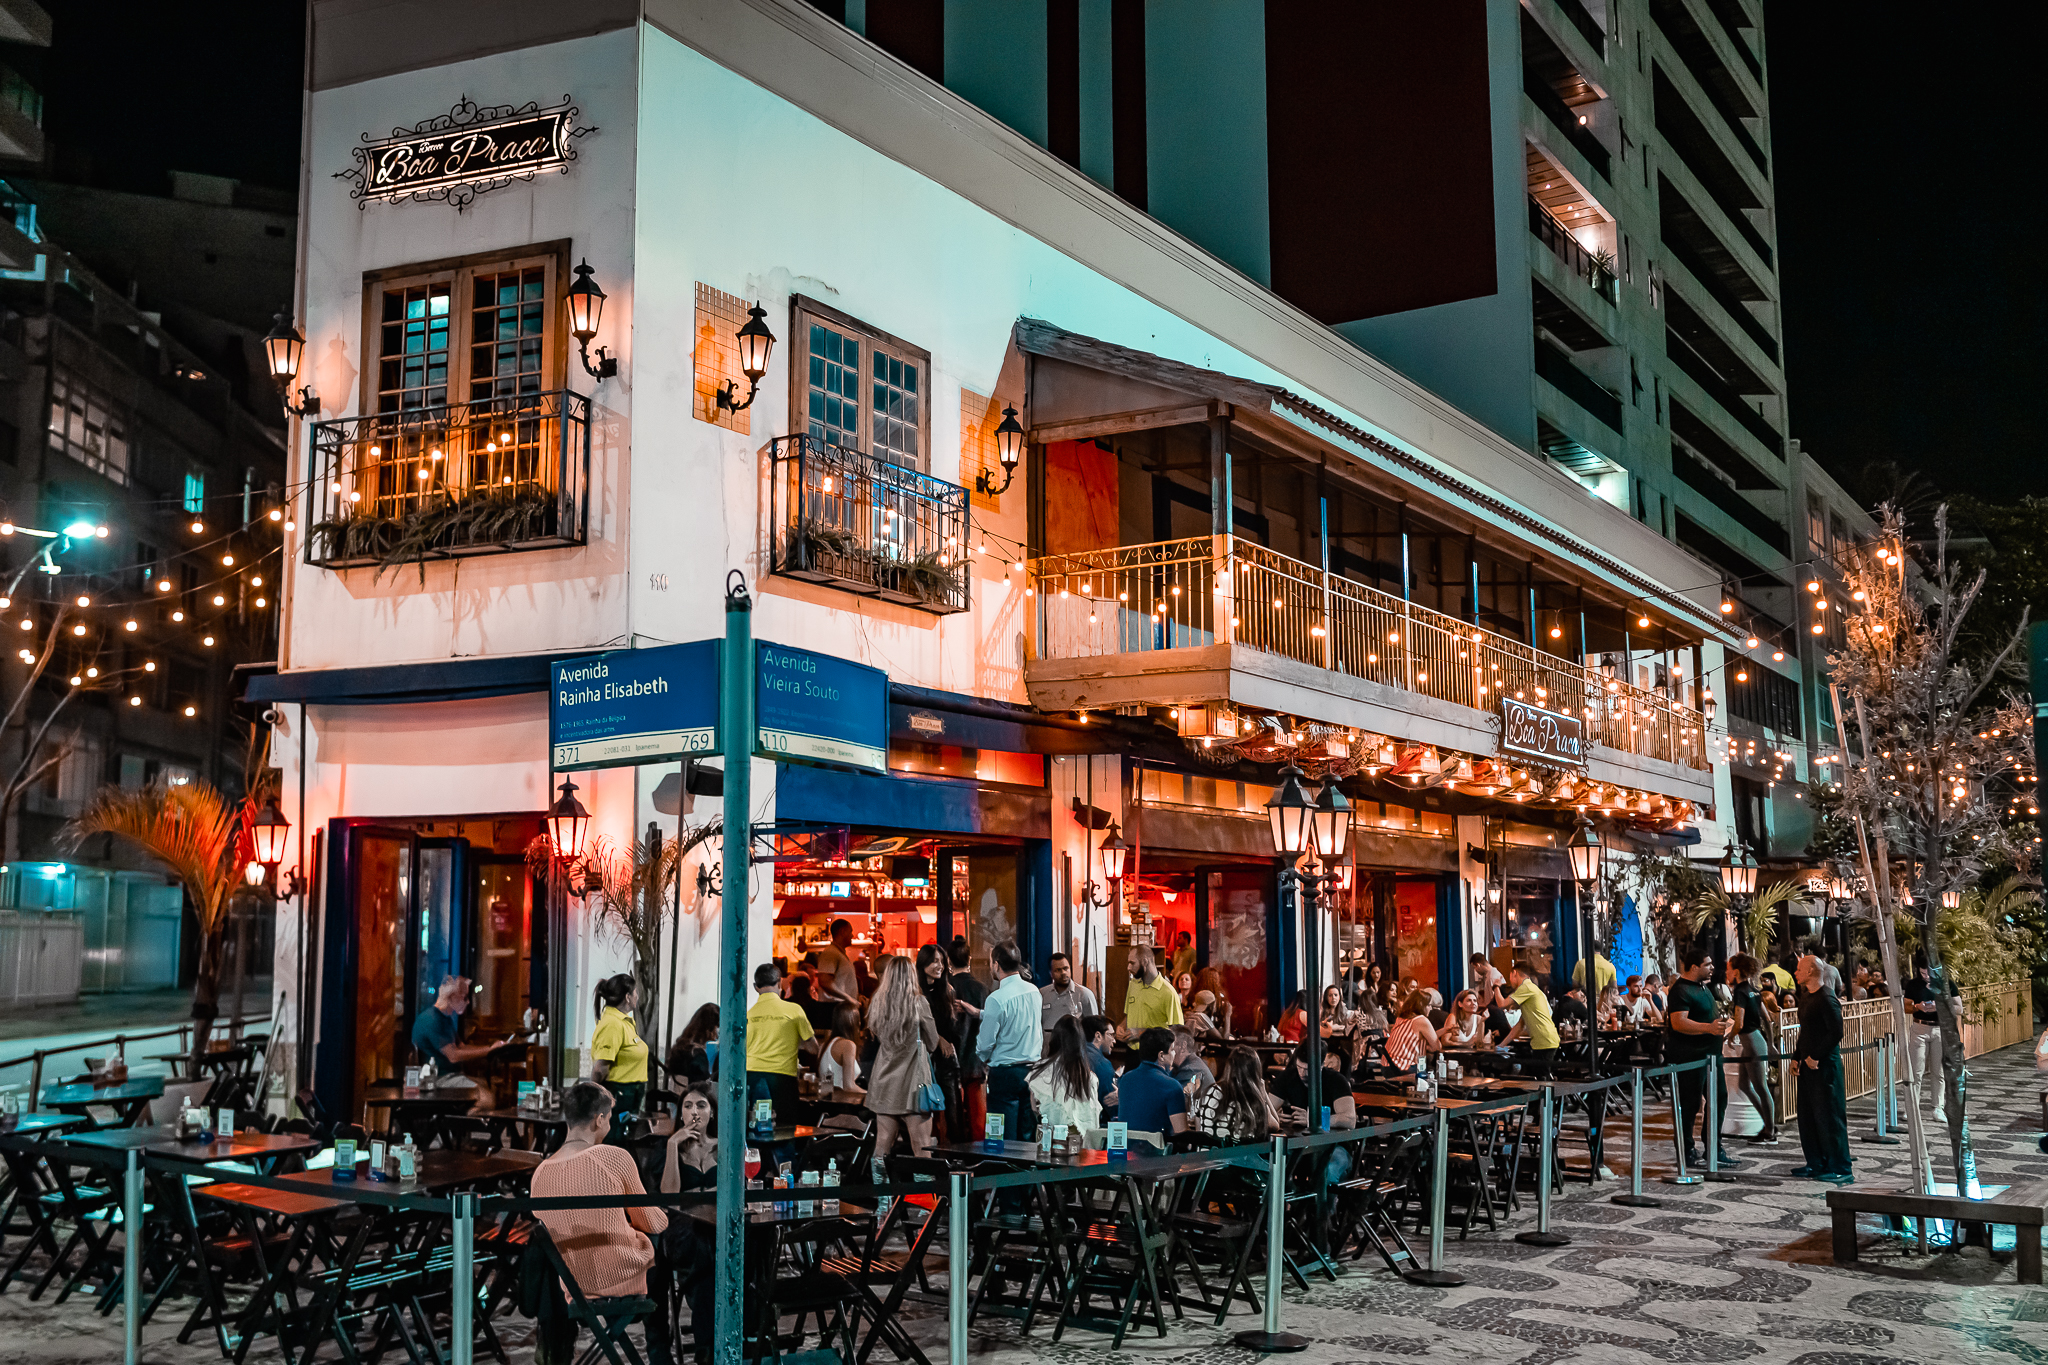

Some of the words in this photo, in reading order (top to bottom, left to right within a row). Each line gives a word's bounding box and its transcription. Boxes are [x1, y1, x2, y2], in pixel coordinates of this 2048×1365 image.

[376, 146, 439, 184] Boa
[444, 134, 550, 176] Praça
[559, 661, 609, 684] Avenida
[763, 650, 816, 674] Avenida
[560, 686, 601, 707] Rainha
[605, 676, 668, 700] Elisabeth
[763, 672, 800, 694] Vieira
[805, 680, 840, 701] Souto
[1509, 705, 1537, 744] Boa
[558, 746, 580, 765] 371
[681, 733, 710, 752] 769
[763, 733, 788, 752] 110
